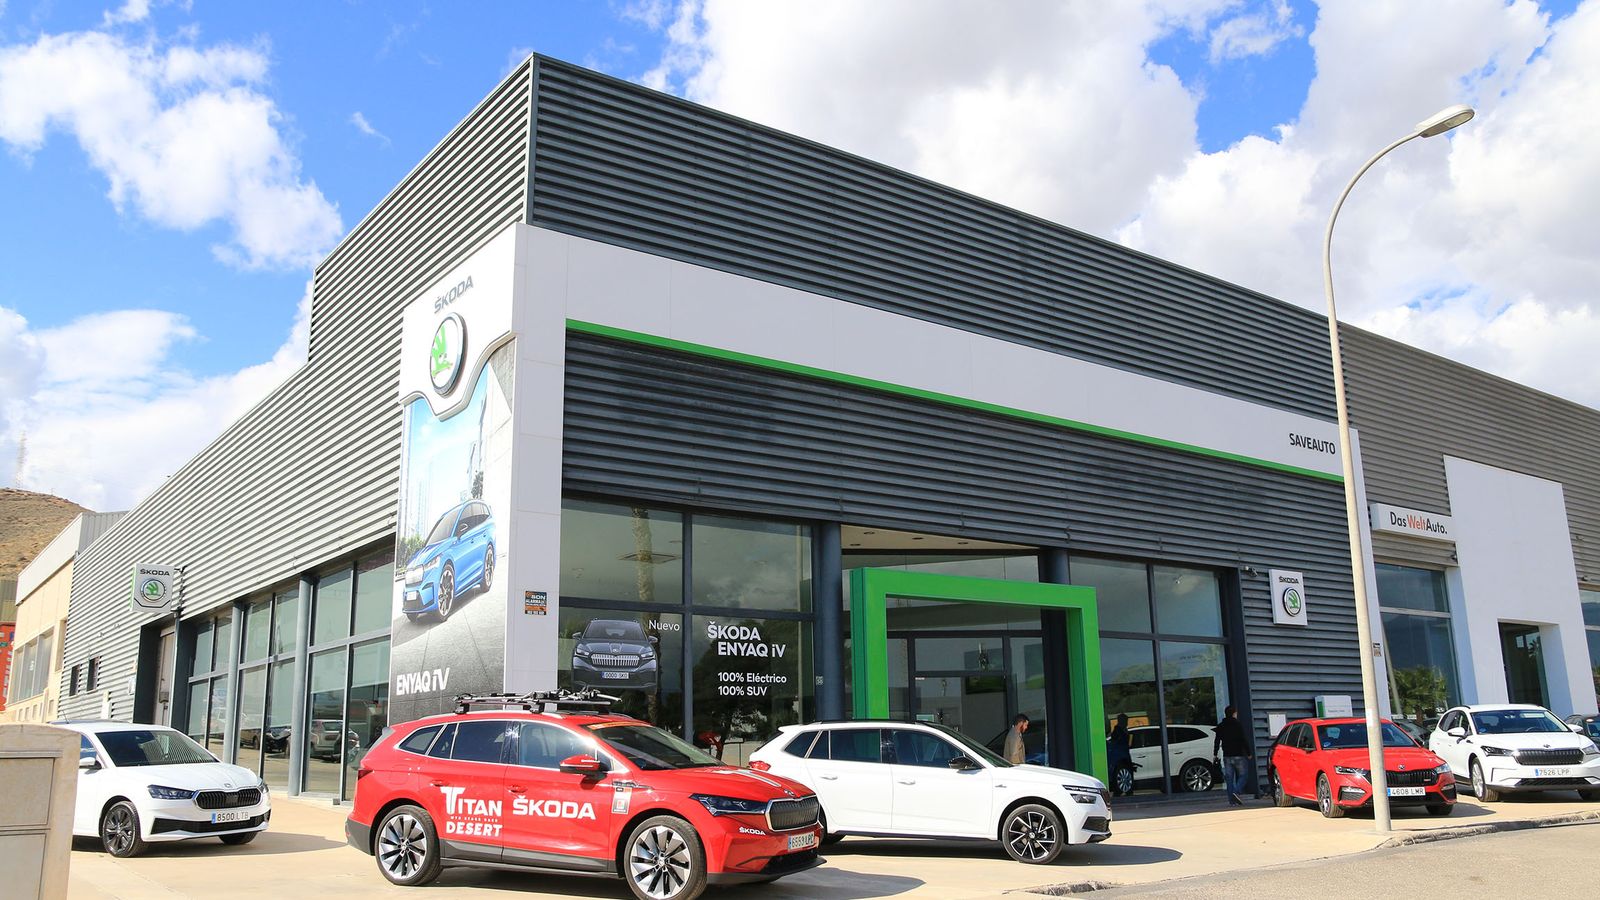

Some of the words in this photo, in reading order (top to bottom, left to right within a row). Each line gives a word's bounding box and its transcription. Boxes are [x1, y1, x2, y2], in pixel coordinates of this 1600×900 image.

[434, 275, 474, 314] ŠKODA
[1289, 433, 1336, 455] SAVEAUTO
[648, 620, 680, 631] Nuevo
[707, 621, 761, 641] ŠKODA
[717, 641, 768, 657] ENYAQ
[771, 643, 786, 658] iV
[396, 670, 430, 695] ENYAQ
[432, 667, 450, 691] iV
[717, 672, 745, 683] 100%
[746, 673, 787, 683] Eléctrico
[717, 686, 745, 696] 100%
[746, 686, 768, 696] SUV
[1392, 788, 1409, 796] 4608
[440, 786, 503, 817] TITAN
[512, 795, 596, 820] ŠKODA
[217, 812, 235, 821] 8500
[446, 821, 503, 837] DESERT
[739, 826, 766, 836] ŠKODA
